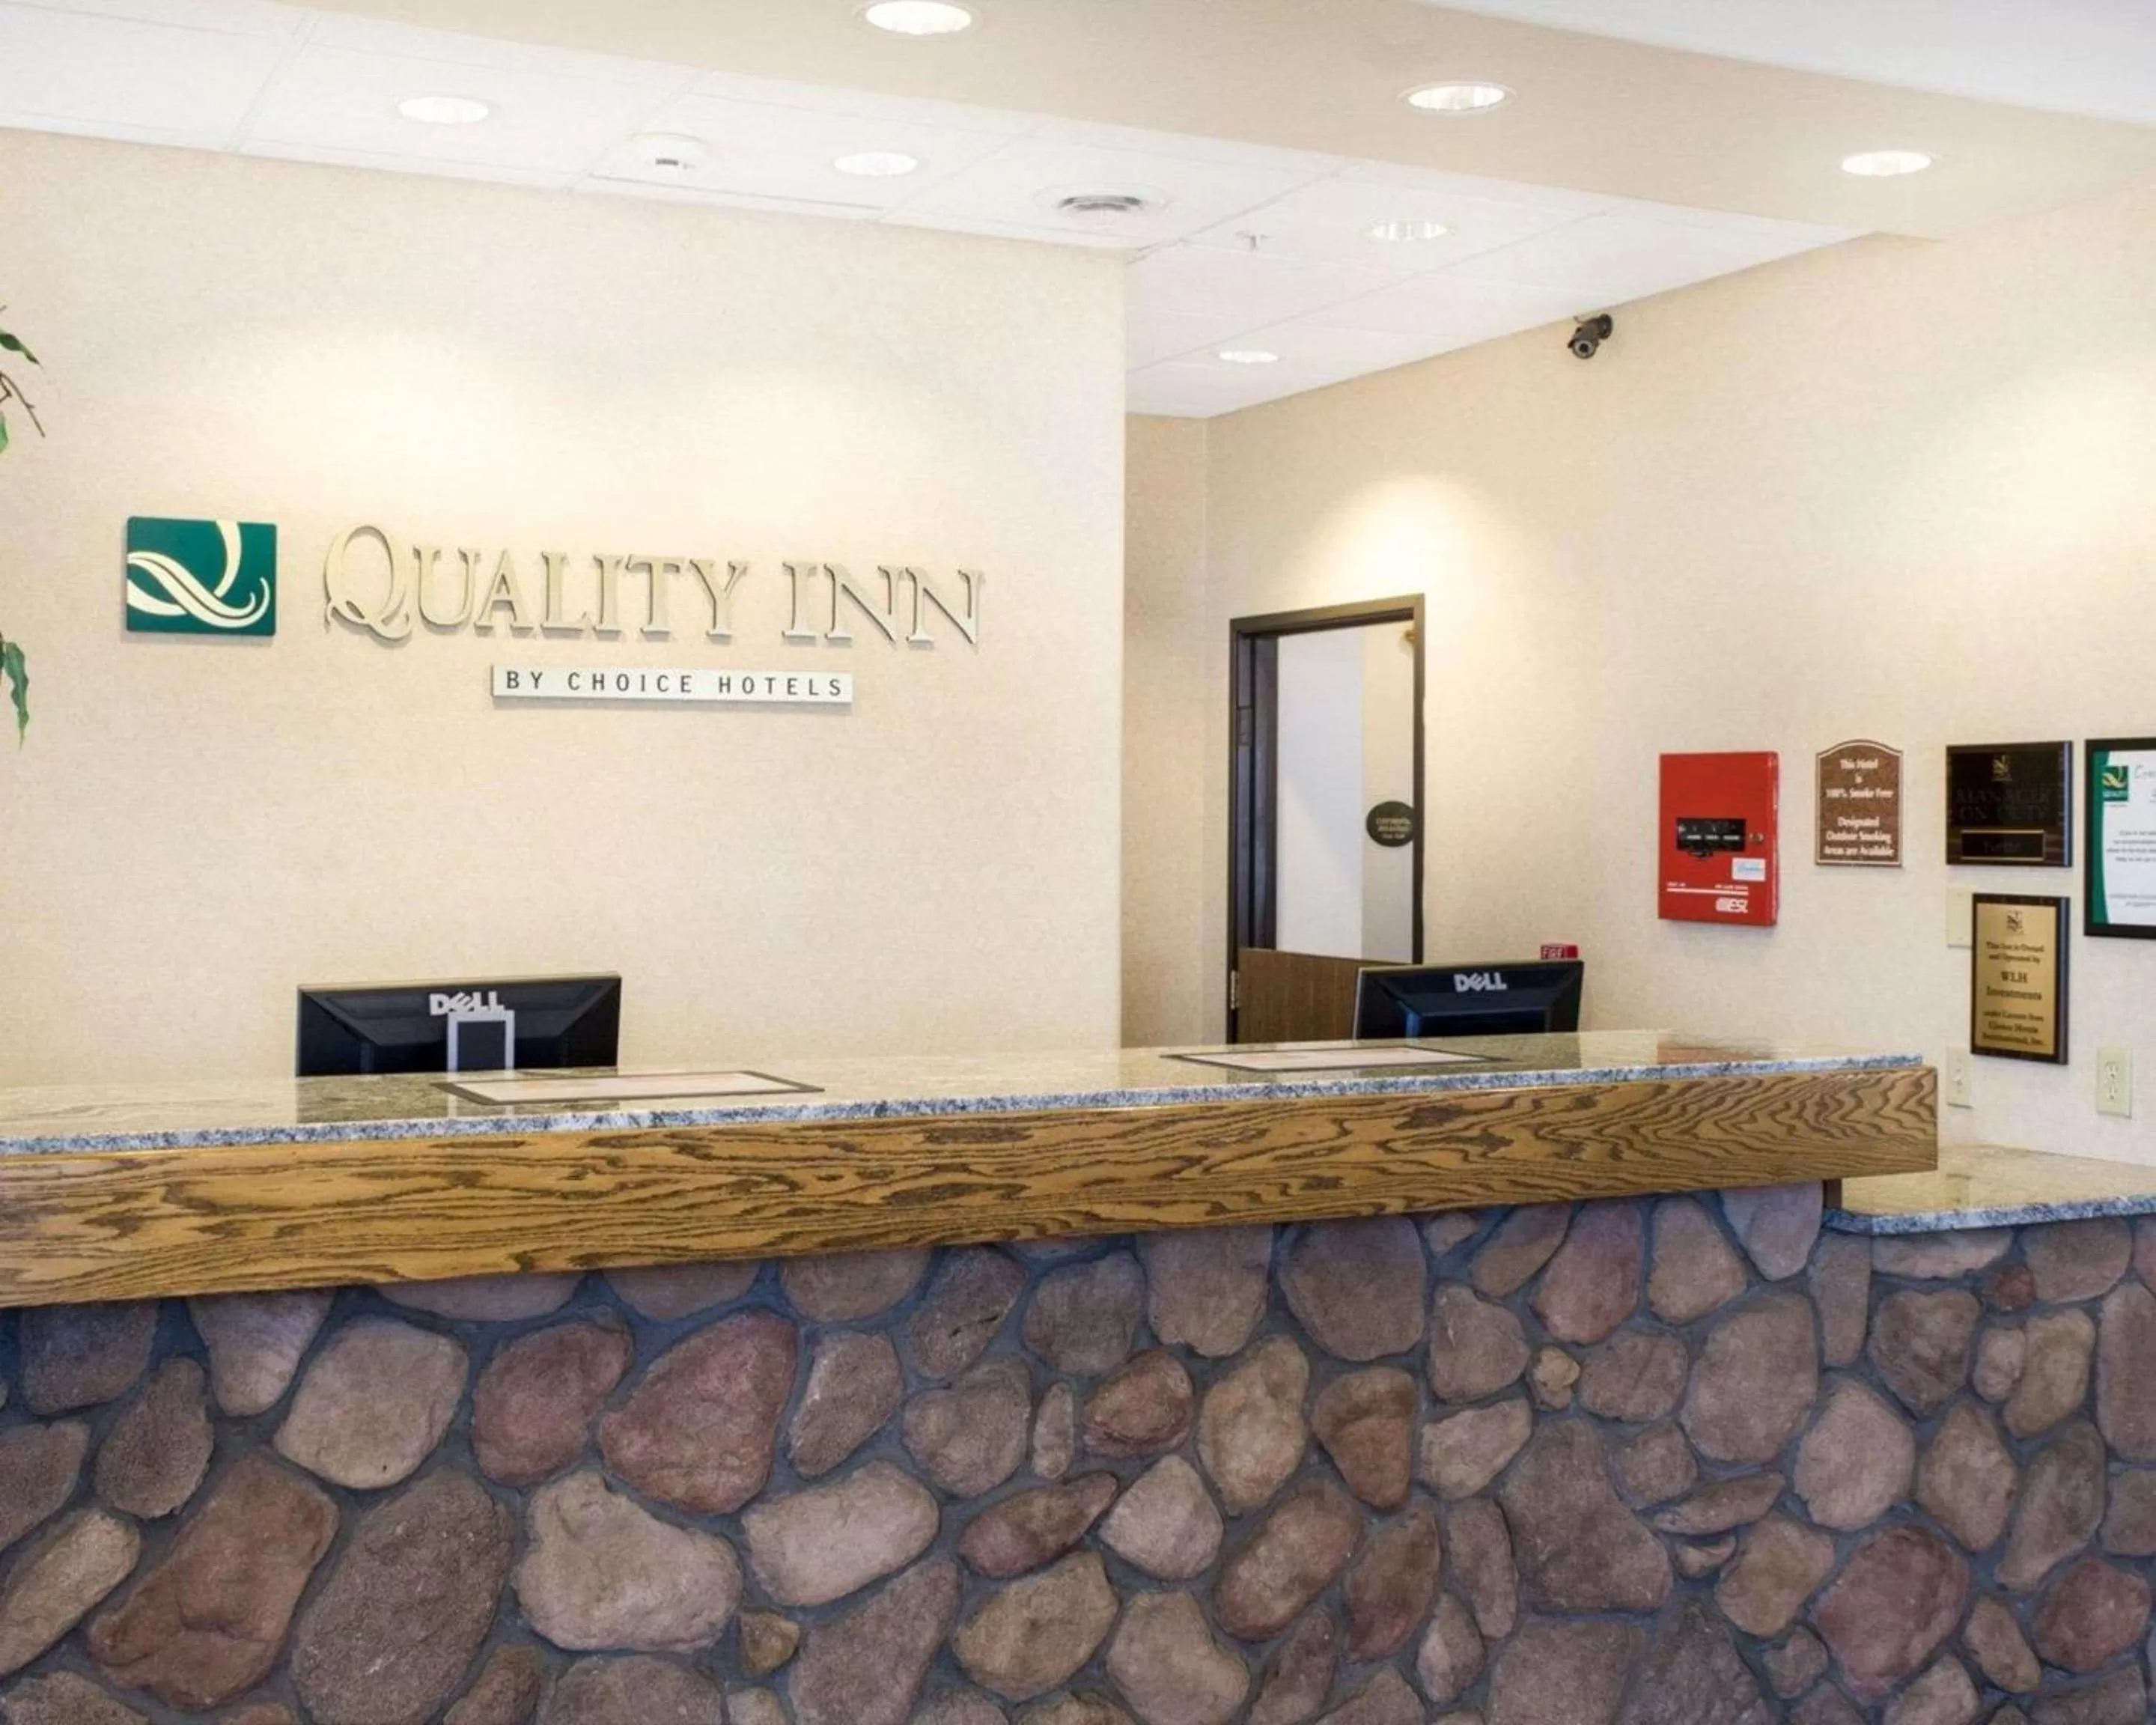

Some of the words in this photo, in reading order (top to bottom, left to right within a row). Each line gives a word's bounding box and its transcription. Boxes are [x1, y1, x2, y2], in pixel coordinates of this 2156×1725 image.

[325, 525, 751, 641] QUALITY
[782, 562, 985, 645] INN
[506, 671, 543, 690] BY
[567, 672, 692, 693] CHOICE
[719, 676, 842, 696] HOTELS
[1453, 972, 1507, 992] DELL
[2000, 971, 2028, 983] WLH
[429, 991, 506, 1016] DELL
